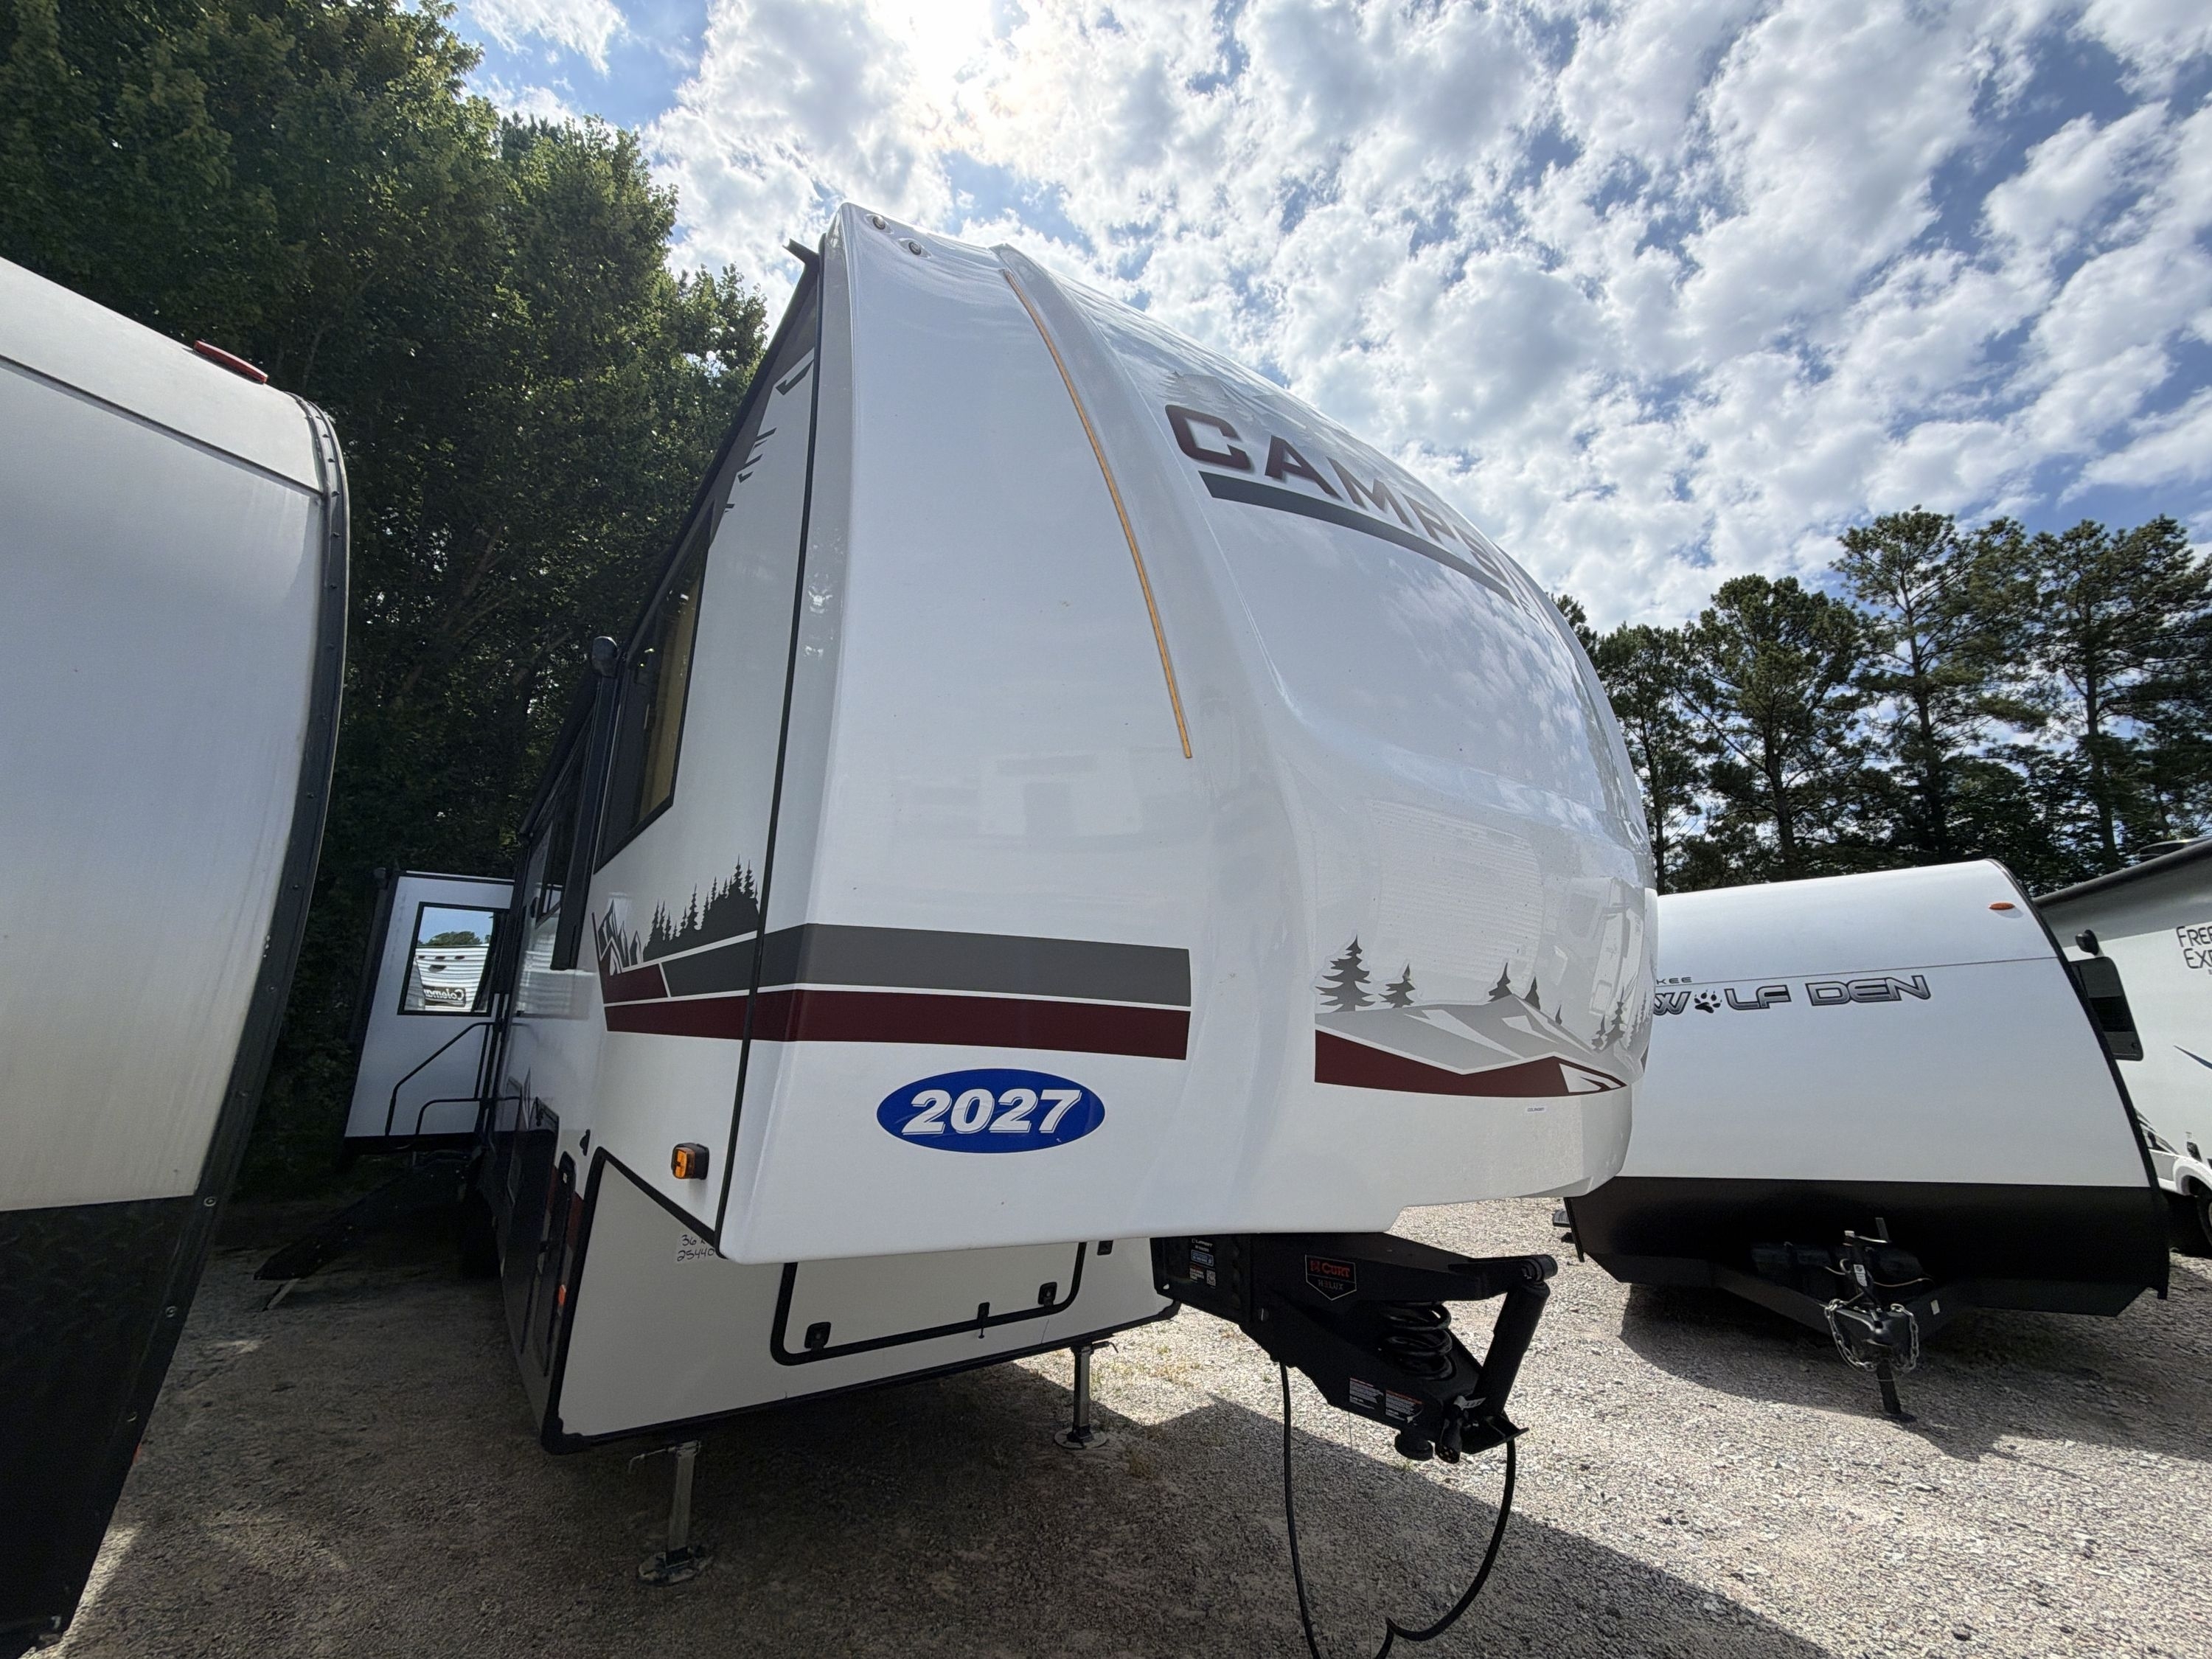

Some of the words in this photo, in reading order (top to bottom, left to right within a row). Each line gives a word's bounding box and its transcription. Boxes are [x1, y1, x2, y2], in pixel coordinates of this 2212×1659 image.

[1656, 977, 1692, 985] KEE
[1805, 975, 1932, 1006] DEN
[901, 1088, 1082, 1135] 2027
[677, 1248, 716, 1262] 25440
[1321, 1262, 1351, 1278] CURT
